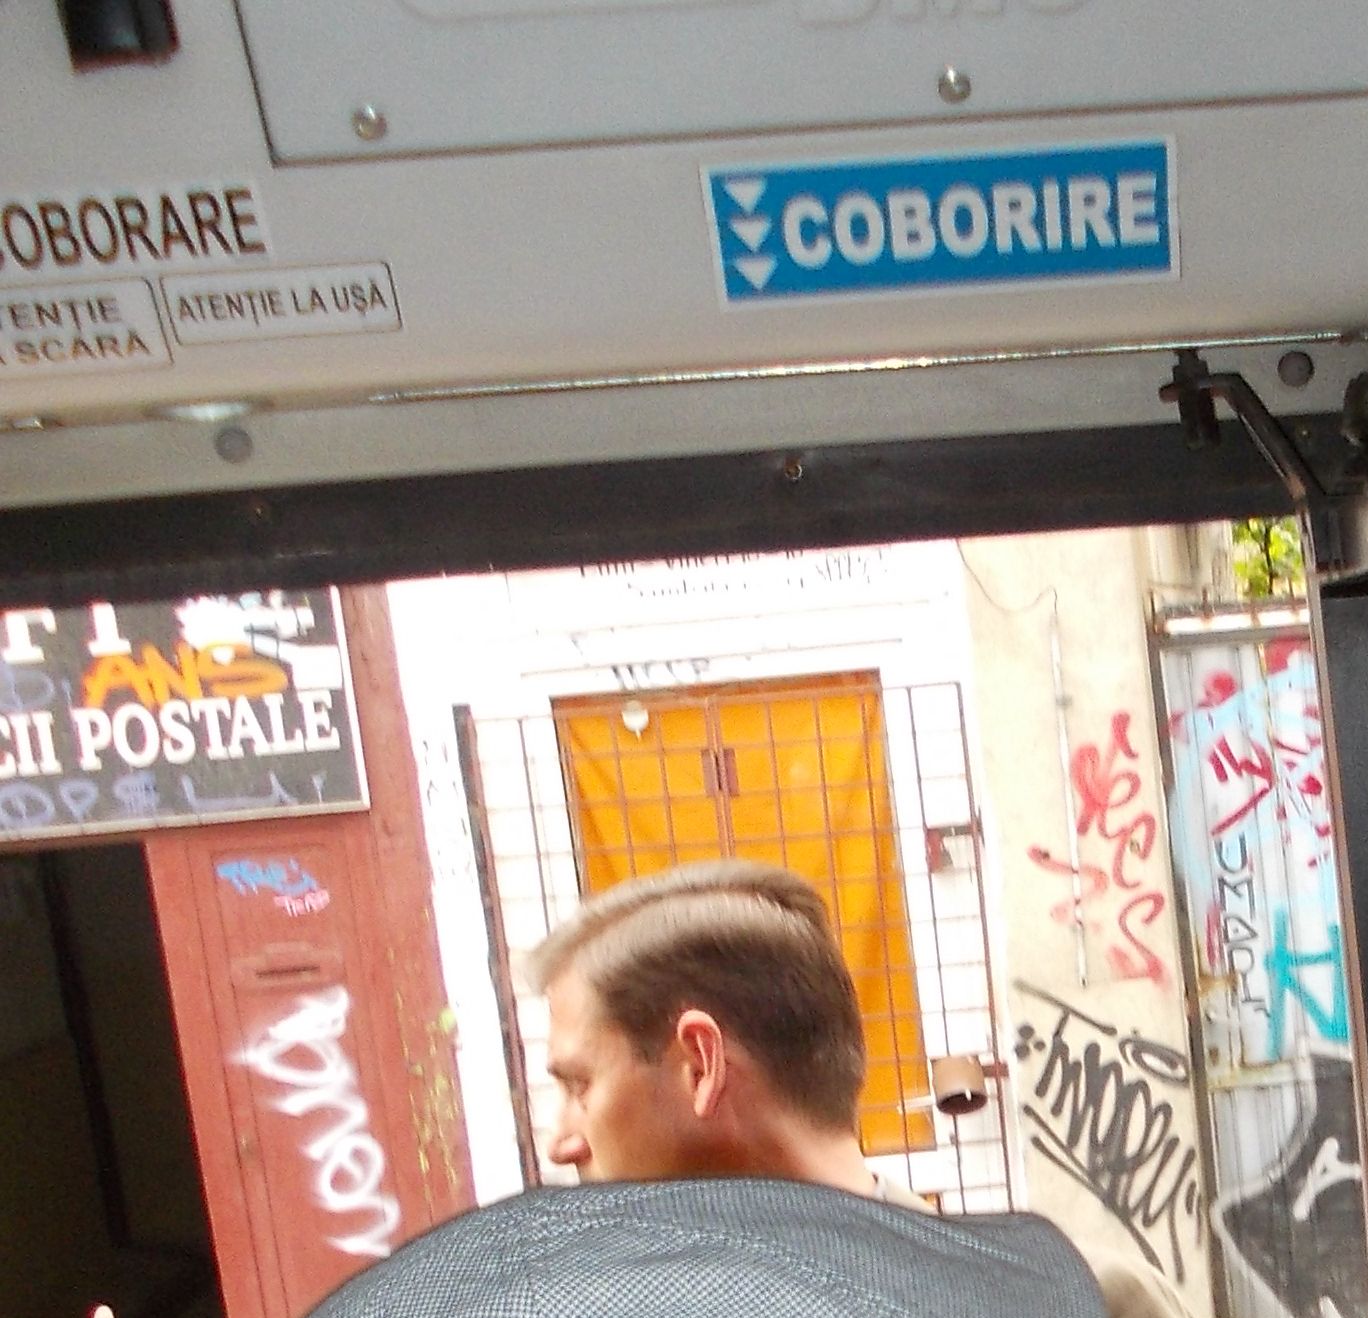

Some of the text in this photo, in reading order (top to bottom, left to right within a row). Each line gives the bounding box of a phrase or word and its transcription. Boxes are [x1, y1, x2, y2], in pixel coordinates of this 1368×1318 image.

[0, 187, 266, 270] OBORARE
[782, 172, 1159, 271] COBORIRE
[0, 295, 123, 332] ENȚIE
[291, 286, 328, 315] LA
[71, 688, 341, 770] POSTALE
